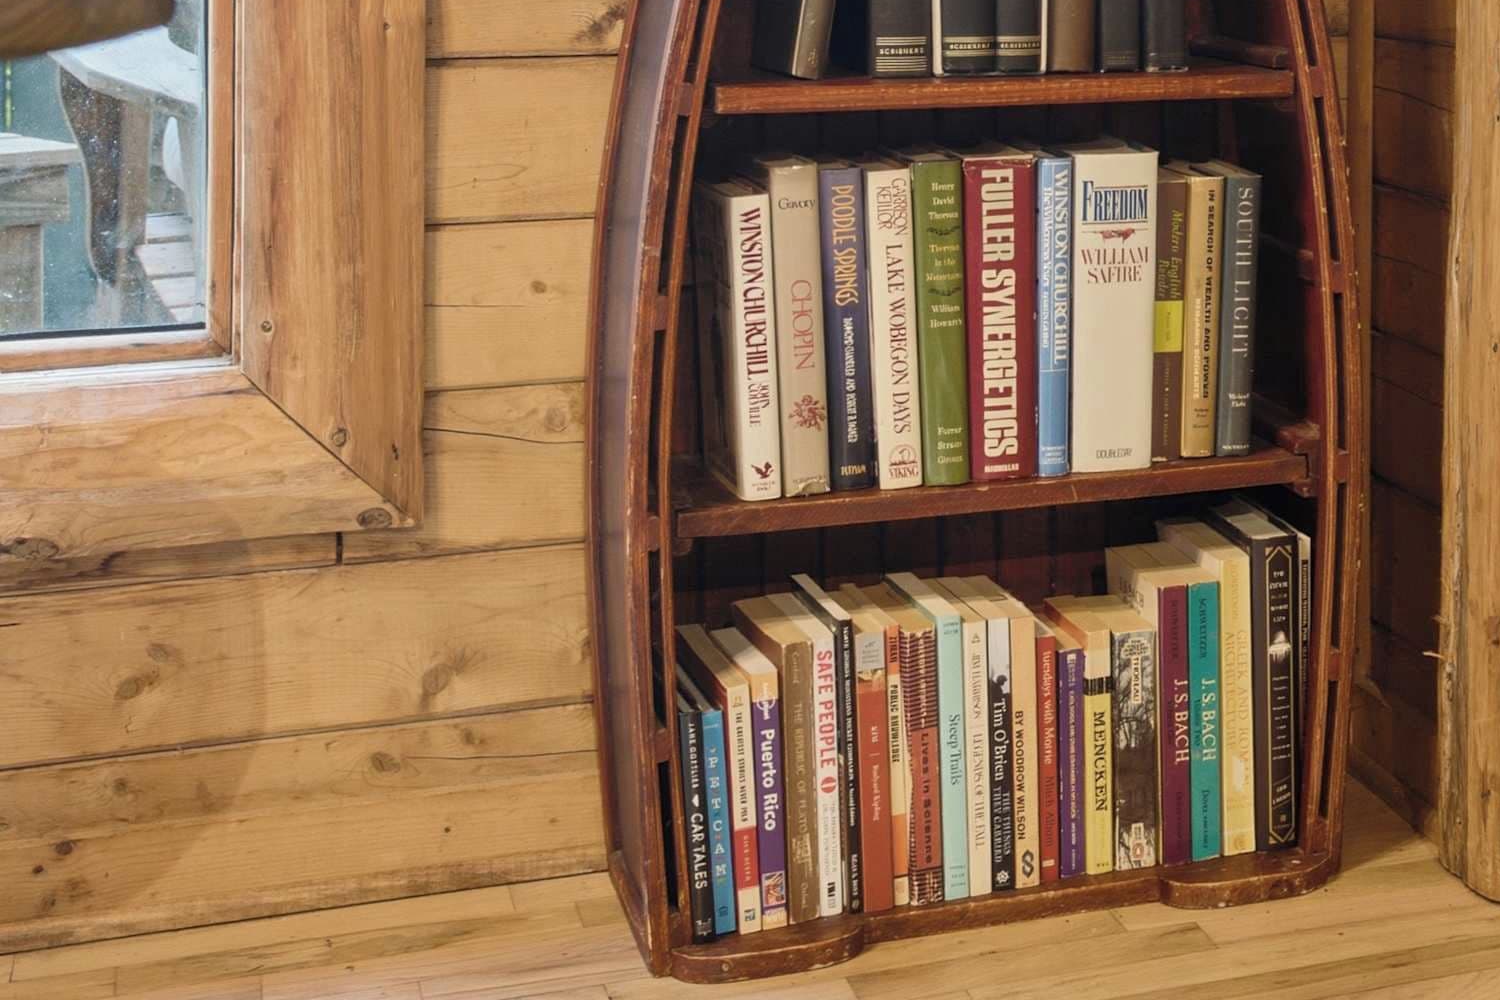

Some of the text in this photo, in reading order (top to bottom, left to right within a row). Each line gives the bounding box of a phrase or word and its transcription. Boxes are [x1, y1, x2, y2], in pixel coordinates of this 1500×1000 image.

[876, 186, 892, 229] KEILLOR
[891, 178, 908, 235] GARRISON
[931, 183, 955, 191] Henry
[932, 197, 955, 205] David
[1082, 180, 1149, 224] FREEDOM
[1208, 189, 1215, 202] IN
[831, 185, 858, 306] POODLE SPRINGS
[1081, 247, 1150, 267] WILLIAM
[1170, 210, 1184, 253] Modern
[1206, 206, 1215, 253] SEARCH
[740, 207, 768, 380] WINSTON CHURCHILL
[1053, 170, 1069, 364] WINSTON CHURCHILL
[1087, 266, 1143, 283] SAFIRE
[1157, 259, 1169, 298] Reader
[1168, 256, 1182, 300] English
[1206, 257, 1213, 271] OF
[1231, 187, 1254, 358] SOUTH LIGHT
[790, 280, 815, 370] CHOPIN
[930, 304, 960, 312] William
[981, 168, 1018, 457] FULLER SYNERGETICS
[1204, 277, 1213, 323] WEALTH
[885, 244, 912, 434] LAKE WOBEGON DAYS
[1203, 328, 1211, 352] AND
[889, 467, 918, 478] VIKING
[1199, 598, 1207, 659] SCHWEITZER
[1132, 657, 1141, 702] THOREAU
[1224, 631, 1236, 750] ARCHITECTURE
[1237, 629, 1250, 721] GREEK AND
[794, 703, 804, 725] THE
[817, 650, 836, 769] SAFE PEOPLE
[890, 684, 900, 763] PUBLIC KNOWLEDGE
[993, 698, 1010, 780] Tim O'Brien
[1174, 679, 1189, 763] J. S. BACH
[1202, 678, 1216, 761] J. S. BACH
[735, 712, 748, 822] THE GREATEST STORIES NEVER TOLD
[760, 729, 779, 831] Puerto Rico
[795, 728, 806, 777] REPUBLIC
[871, 725, 881, 822] KIM Rudyard Kipling
[921, 733, 929, 775] Lives
[946, 714, 962, 786] Steep Trails
[972, 652, 986, 850] JIM HARRISON LEGENDS OF THE FALL
[1014, 710, 1027, 840] BY WOODROW WILSON
[1042, 651, 1057, 847] tuesdays with Morrie Mitch Albom
[1093, 711, 1107, 812] MENCKEN
[687, 723, 708, 890] JANE GOTTLIEB CAR TALES
[796, 780, 806, 794] OF
[797, 800, 807, 833] PLATO
[923, 780, 930, 794] in
[992, 786, 1003, 863] THEY CARRIED
[1001, 792, 1012, 856] THE THINGS
